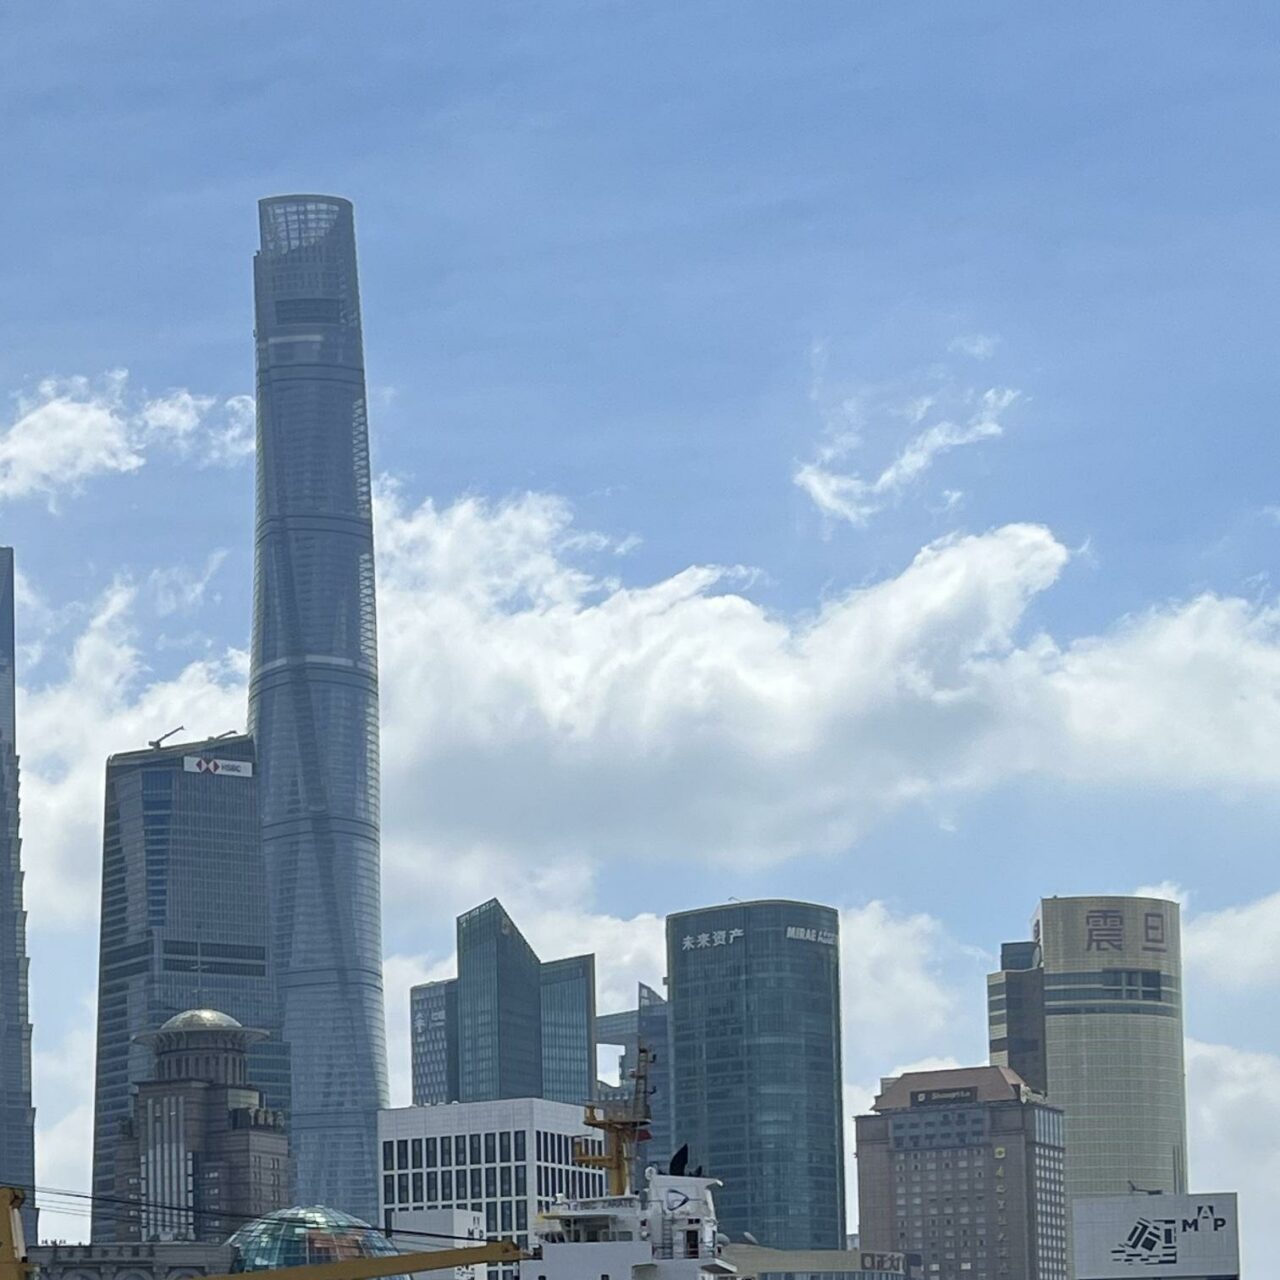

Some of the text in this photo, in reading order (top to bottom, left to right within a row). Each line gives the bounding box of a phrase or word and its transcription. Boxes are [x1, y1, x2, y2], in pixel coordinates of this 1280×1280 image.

[681, 928, 745, 951] 未来资产
[786, 926, 817, 942] MIRAE
[1086, 909, 1168, 953] 震旦
